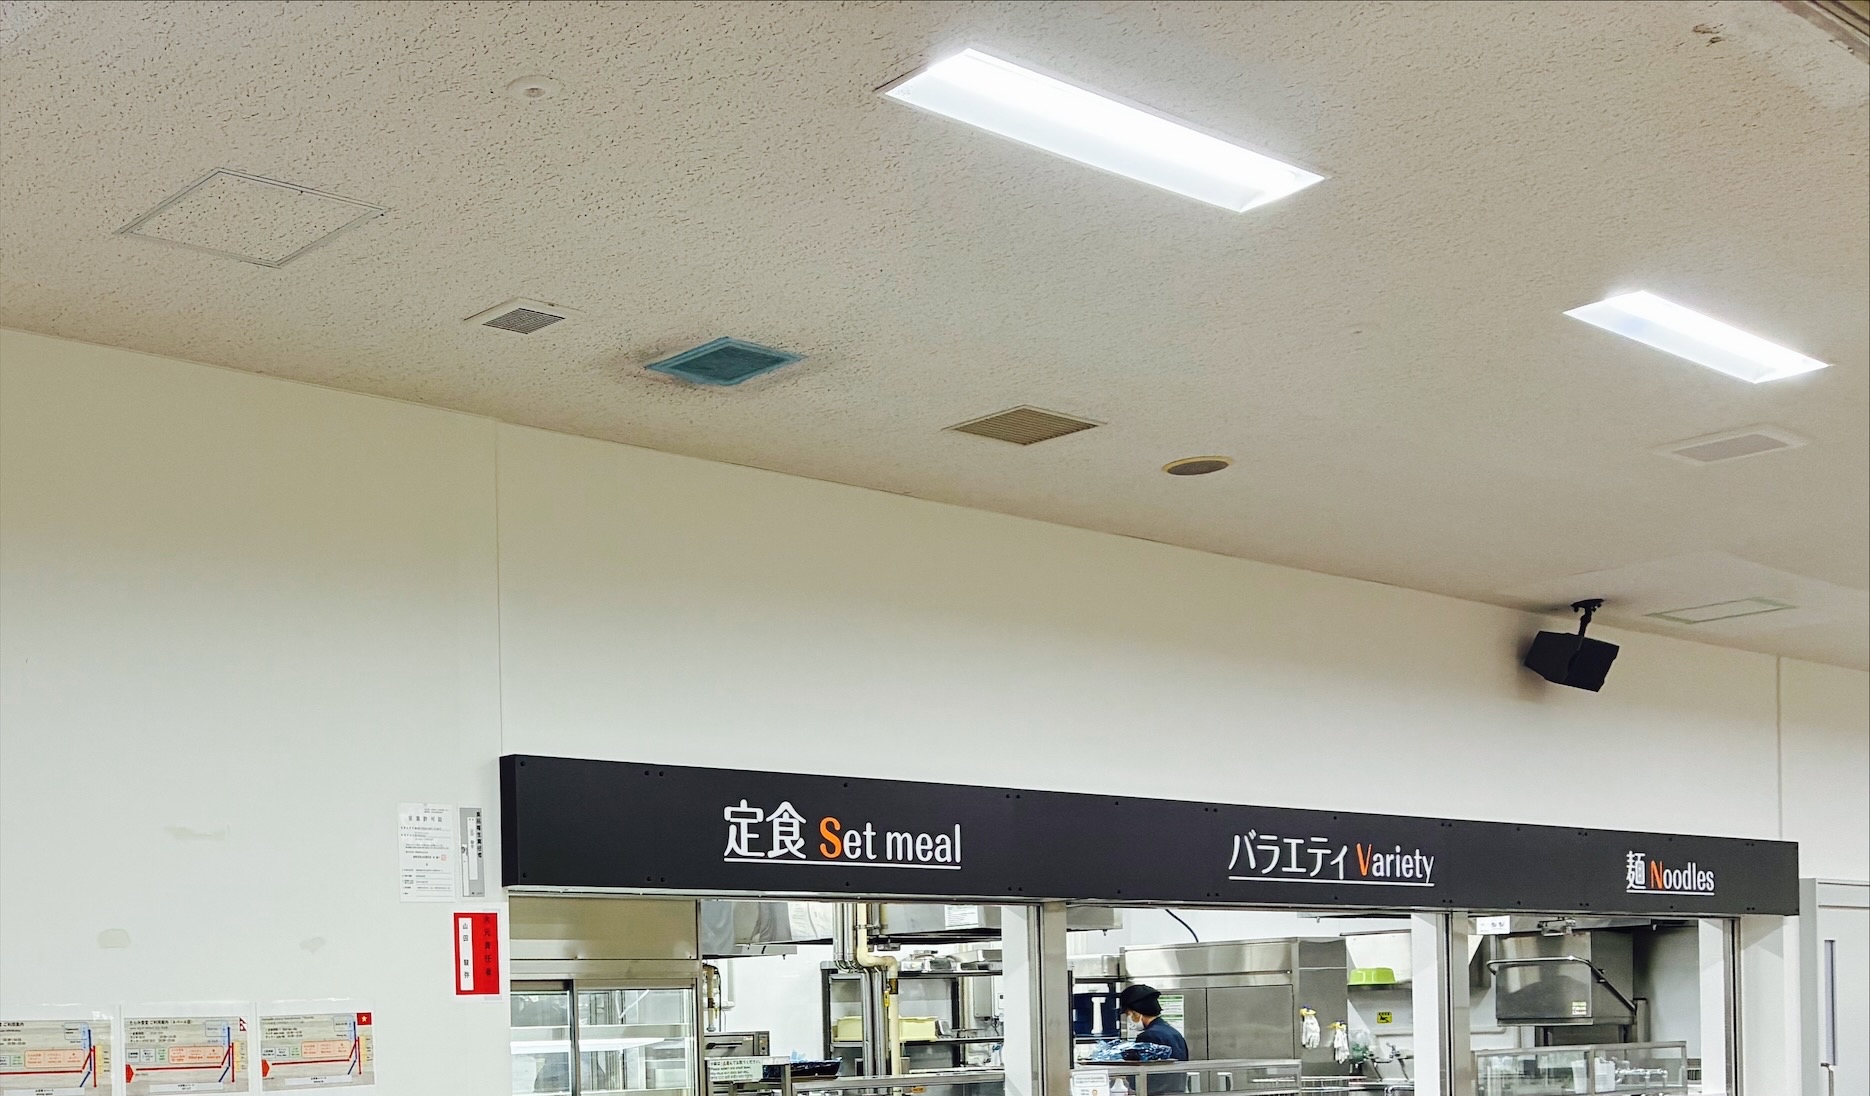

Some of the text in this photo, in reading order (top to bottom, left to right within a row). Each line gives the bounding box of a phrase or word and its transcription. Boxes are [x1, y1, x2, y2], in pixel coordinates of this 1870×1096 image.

[723, 799, 807, 859] 定食
[819, 816, 961, 863] Set meal
[1228, 829, 1348, 880] バラエティ
[1355, 843, 1435, 884] Variety
[1626, 850, 1646, 889] 麺
[1650, 860, 1715, 891] Noodles
